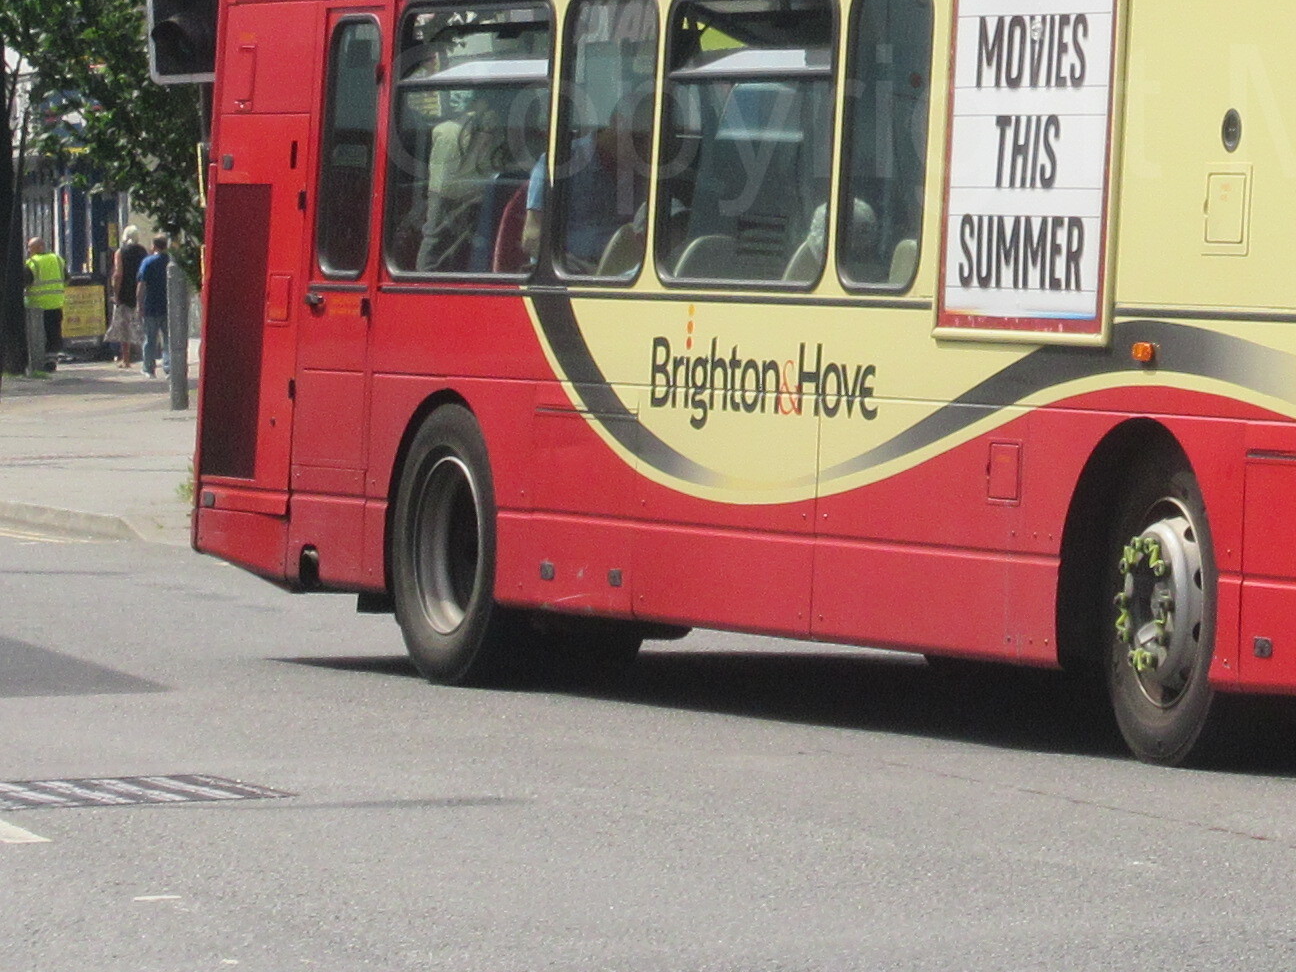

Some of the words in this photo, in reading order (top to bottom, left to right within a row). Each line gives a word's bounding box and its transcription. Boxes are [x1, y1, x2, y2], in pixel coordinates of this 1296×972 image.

[975, 13, 1089, 90] MOVIES
[994, 113, 1061, 190] THIS
[957, 213, 1085, 292] SUMMER
